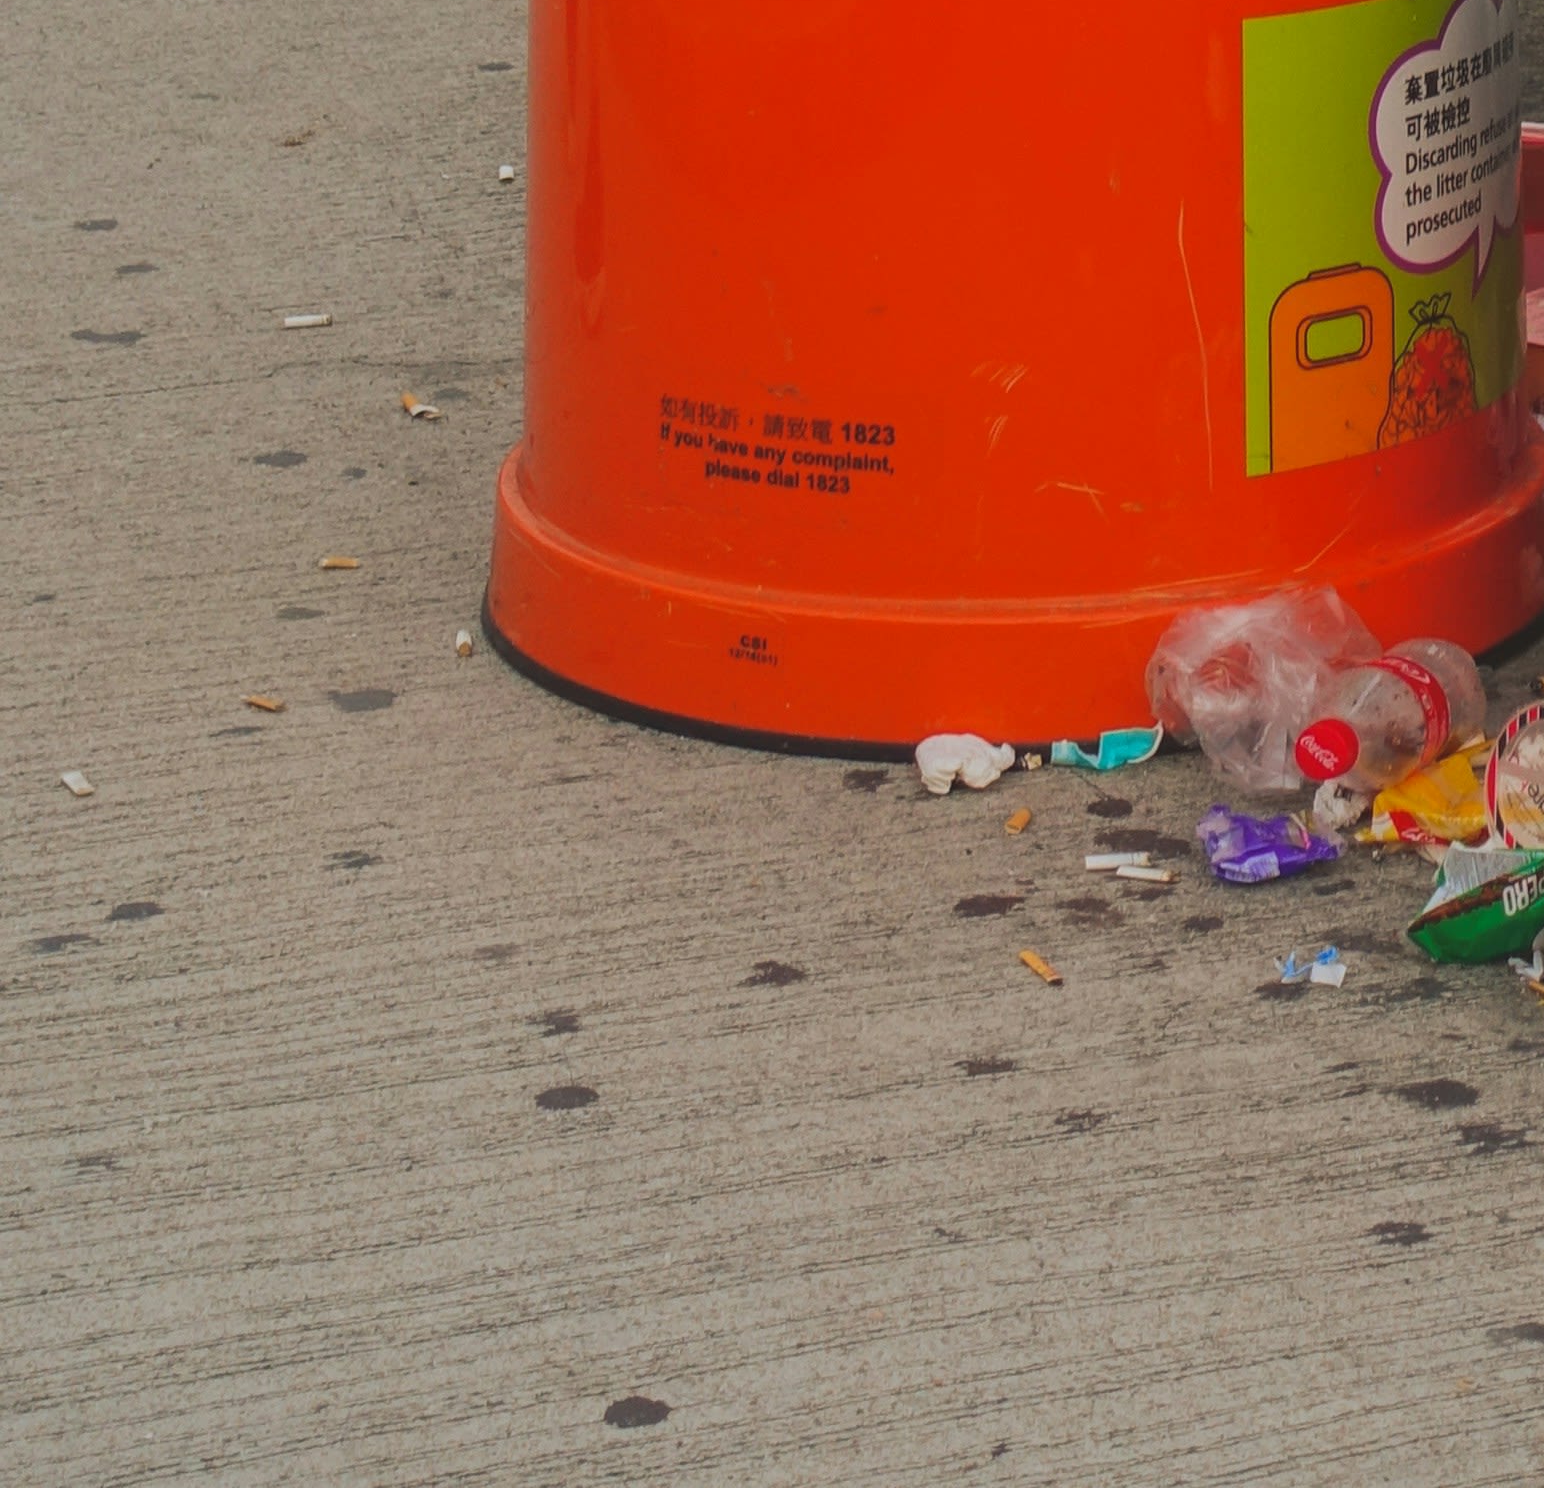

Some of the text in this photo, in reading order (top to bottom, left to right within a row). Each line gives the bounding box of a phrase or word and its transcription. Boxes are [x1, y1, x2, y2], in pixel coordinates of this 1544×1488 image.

[1405, 96, 1471, 142] 可被檢控
[1405, 134, 1478, 175] Discarding
[1405, 182, 1432, 207] the
[1436, 168, 1469, 198] litter
[1406, 188, 1482, 247] prosecuted
[660, 422, 895, 474] If you have any complaint,
[841, 423, 896, 446] 1823
[705, 459, 850, 494] please dial 1823
